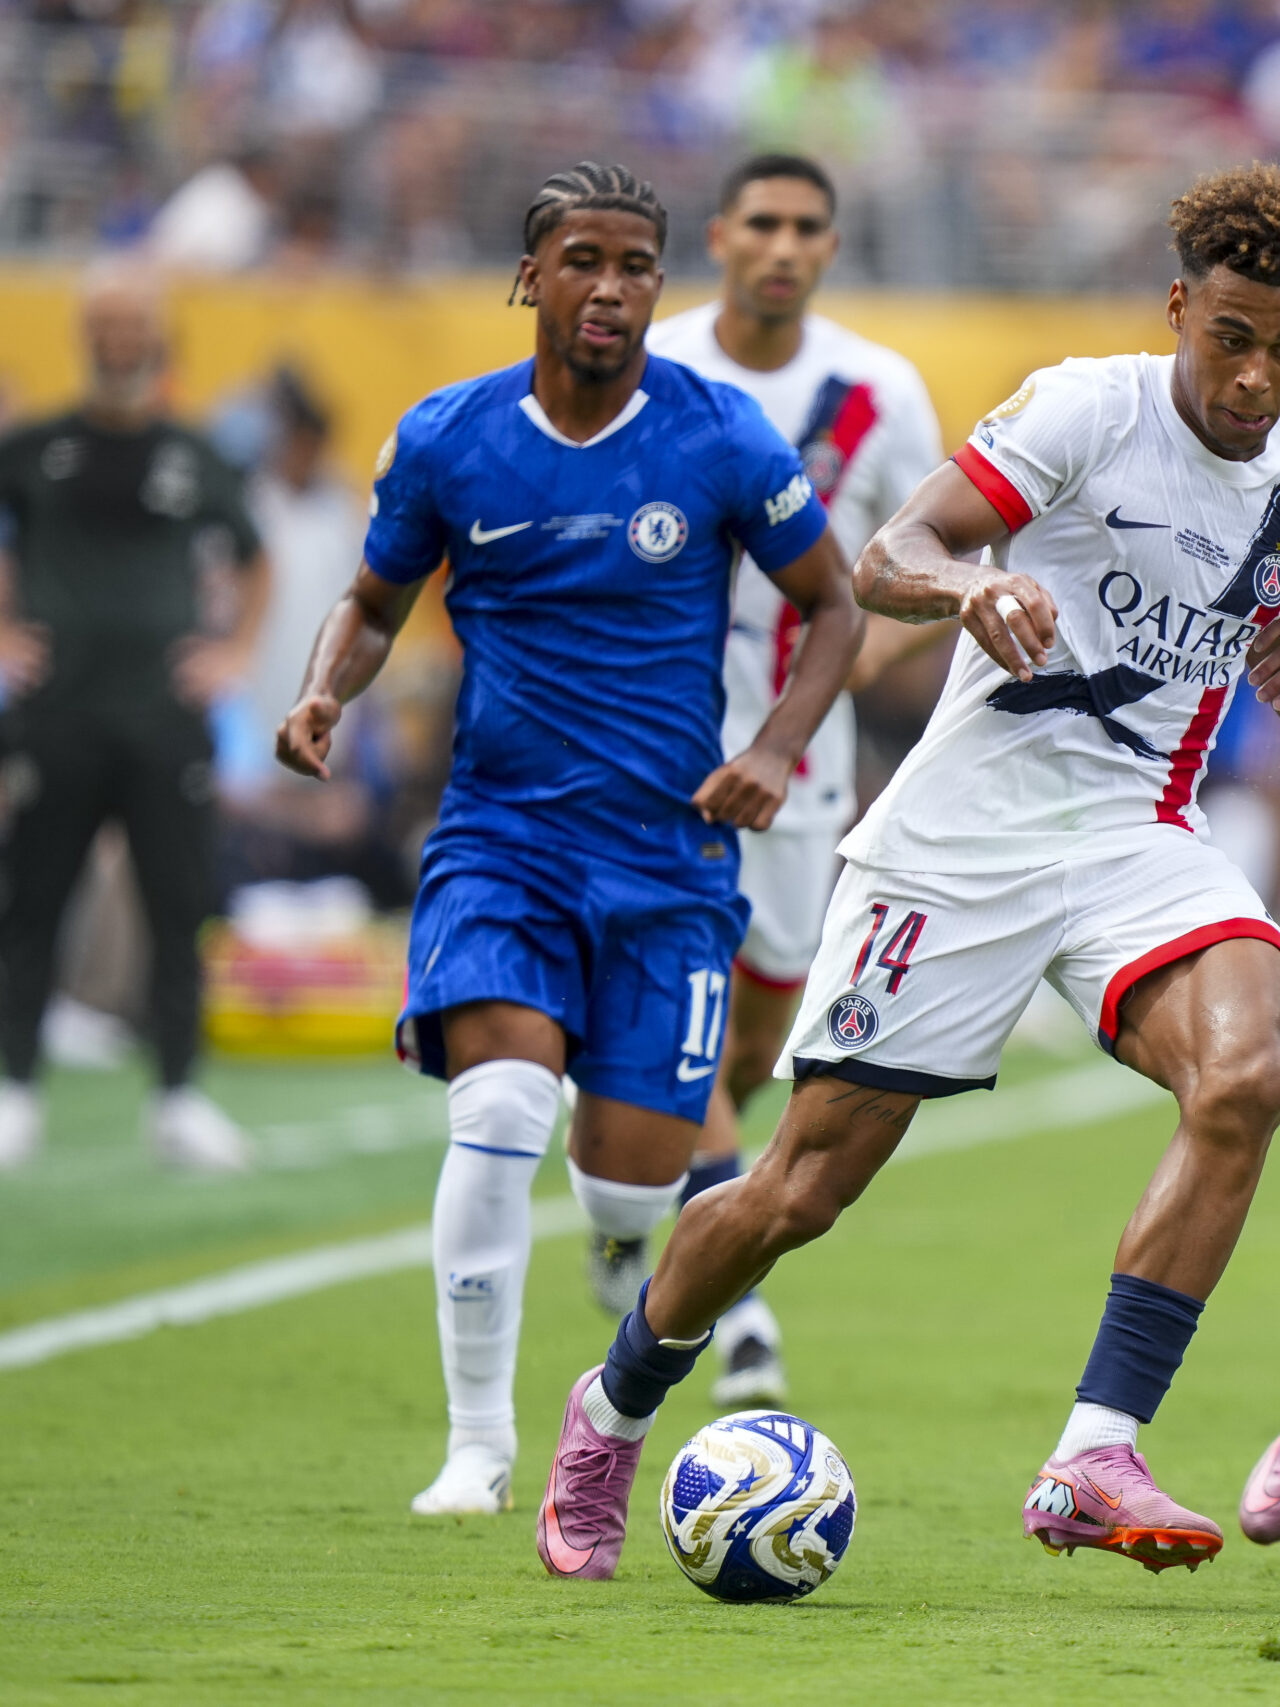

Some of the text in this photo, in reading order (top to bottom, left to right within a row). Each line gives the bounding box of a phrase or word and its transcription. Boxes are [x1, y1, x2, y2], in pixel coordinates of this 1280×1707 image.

[1098, 570, 1256, 658] QATAR
[1116, 635, 1232, 686] AIRWAYS
[850, 902, 928, 995] 14
[681, 967, 727, 1061] 17
[840, 998, 871, 1016] PARIS
